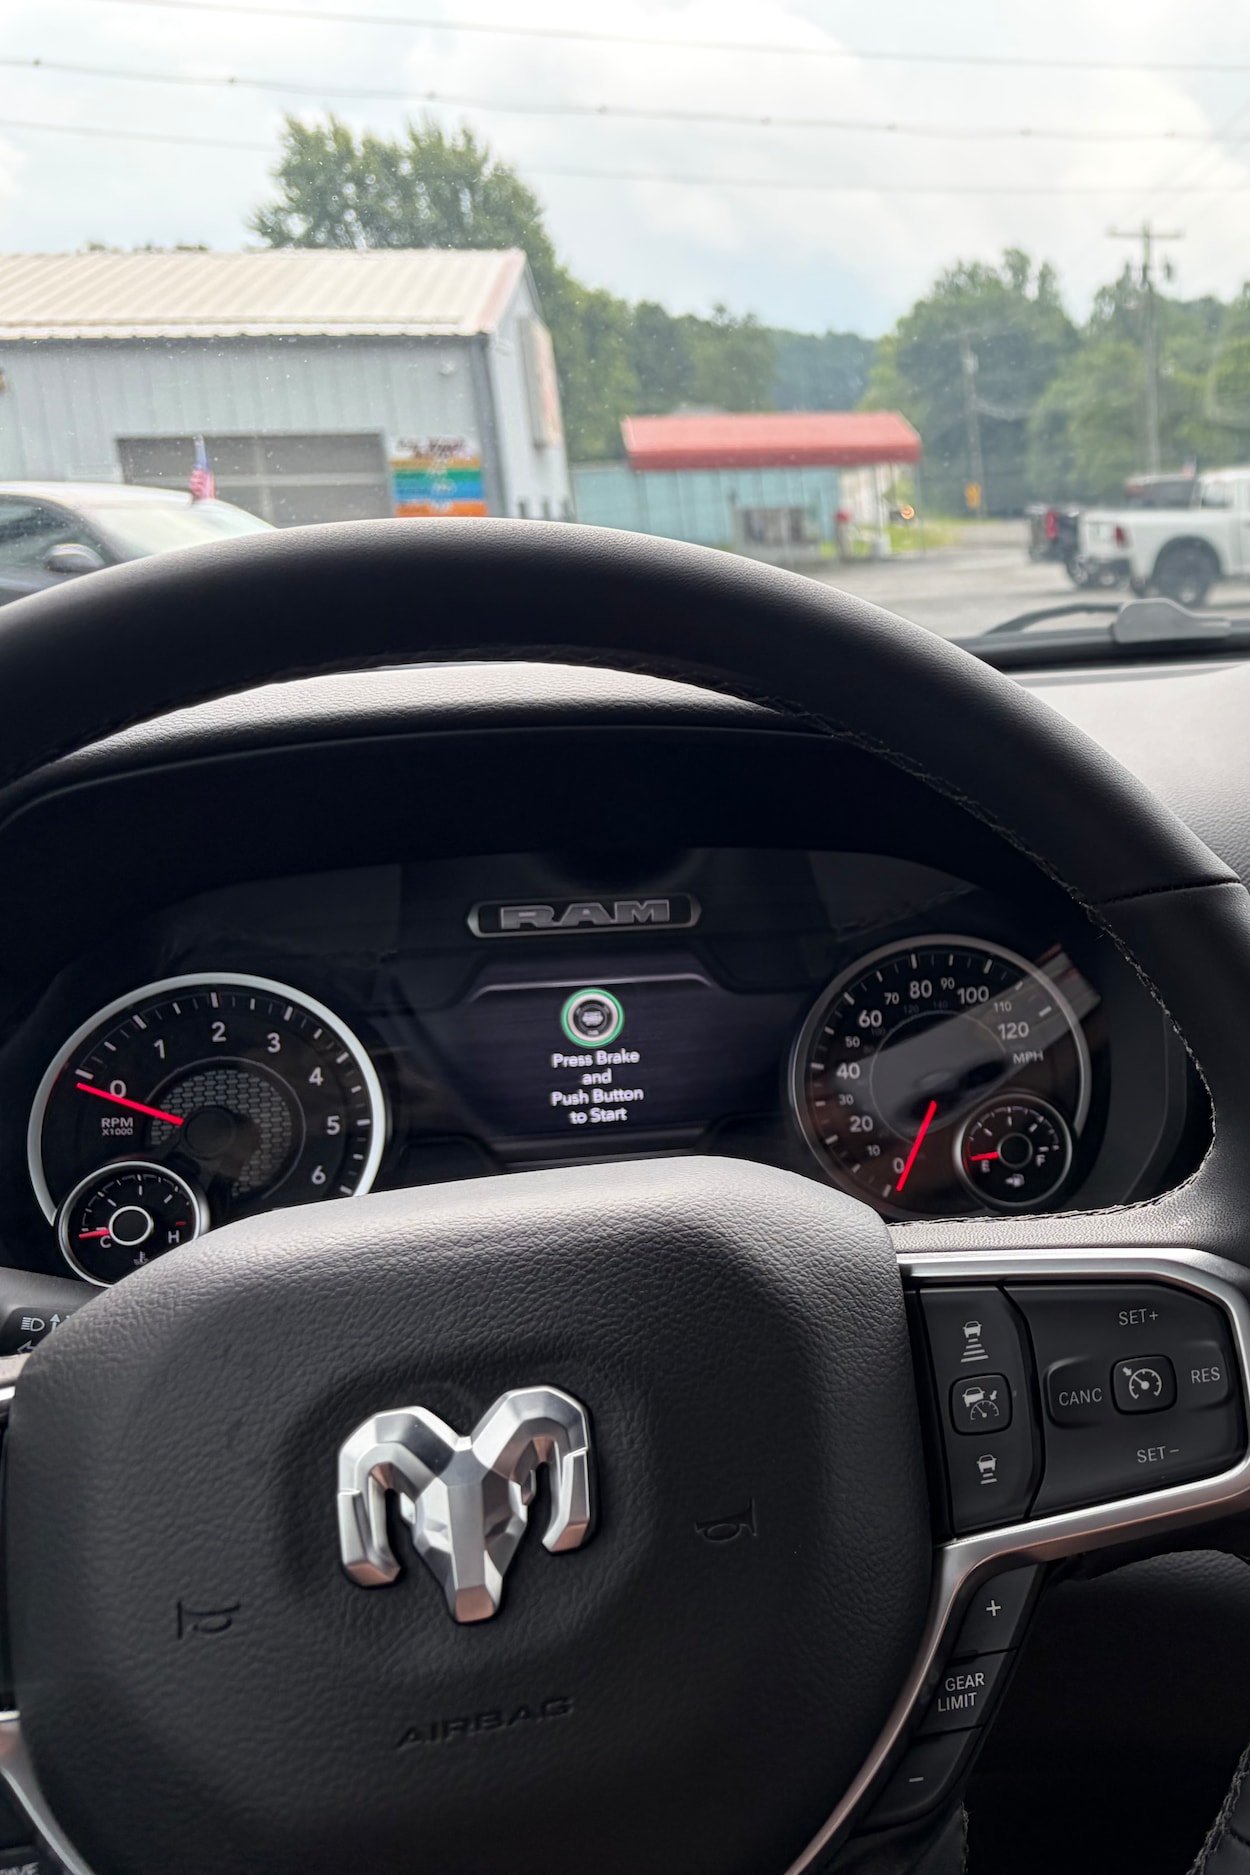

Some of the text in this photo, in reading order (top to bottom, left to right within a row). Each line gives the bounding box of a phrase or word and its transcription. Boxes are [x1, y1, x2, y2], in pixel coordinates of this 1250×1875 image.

[500, 899, 670, 930] RAM
[909, 979, 932, 999] 80
[940, 977, 955, 991] 90
[884, 992, 900, 1006] 70
[957, 986, 989, 1005] 100
[993, 1001, 1012, 1013] 110
[858, 1009, 882, 1028] 60
[212, 1022, 227, 1042] 2
[998, 1022, 1029, 1039] 120
[154, 1040, 166, 1058] 1
[267, 1034, 281, 1052] 3
[845, 1036, 860, 1048] 50
[552, 1048, 640, 1068] Press Brake
[1013, 1051, 1044, 1064] MPH
[309, 1067, 323, 1086] 4
[582, 1069, 612, 1085] and
[836, 1062, 861, 1080] 40
[110, 1079, 127, 1098] 0
[551, 1088, 644, 1106] Push Button
[839, 1094, 854, 1106] 30
[101, 1115, 133, 1129] RPM
[326, 1115, 340, 1134] 5
[569, 1108, 628, 1124] to Start
[850, 1115, 873, 1133] 20
[866, 1145, 880, 1157] 10
[981, 1159, 990, 1173] E
[1036, 1154, 1045, 1168] F
[311, 1166, 325, 1185] 6
[100, 1236, 111, 1249] C
[168, 1230, 180, 1244] H
[1191, 1366, 1220, 1384] RES
[1058, 1387, 1102, 1407] CANC
[945, 1672, 984, 1691] GEAR
[938, 1692, 977, 1712] LIMIT
[396, 1697, 574, 1750] AIRBAG
